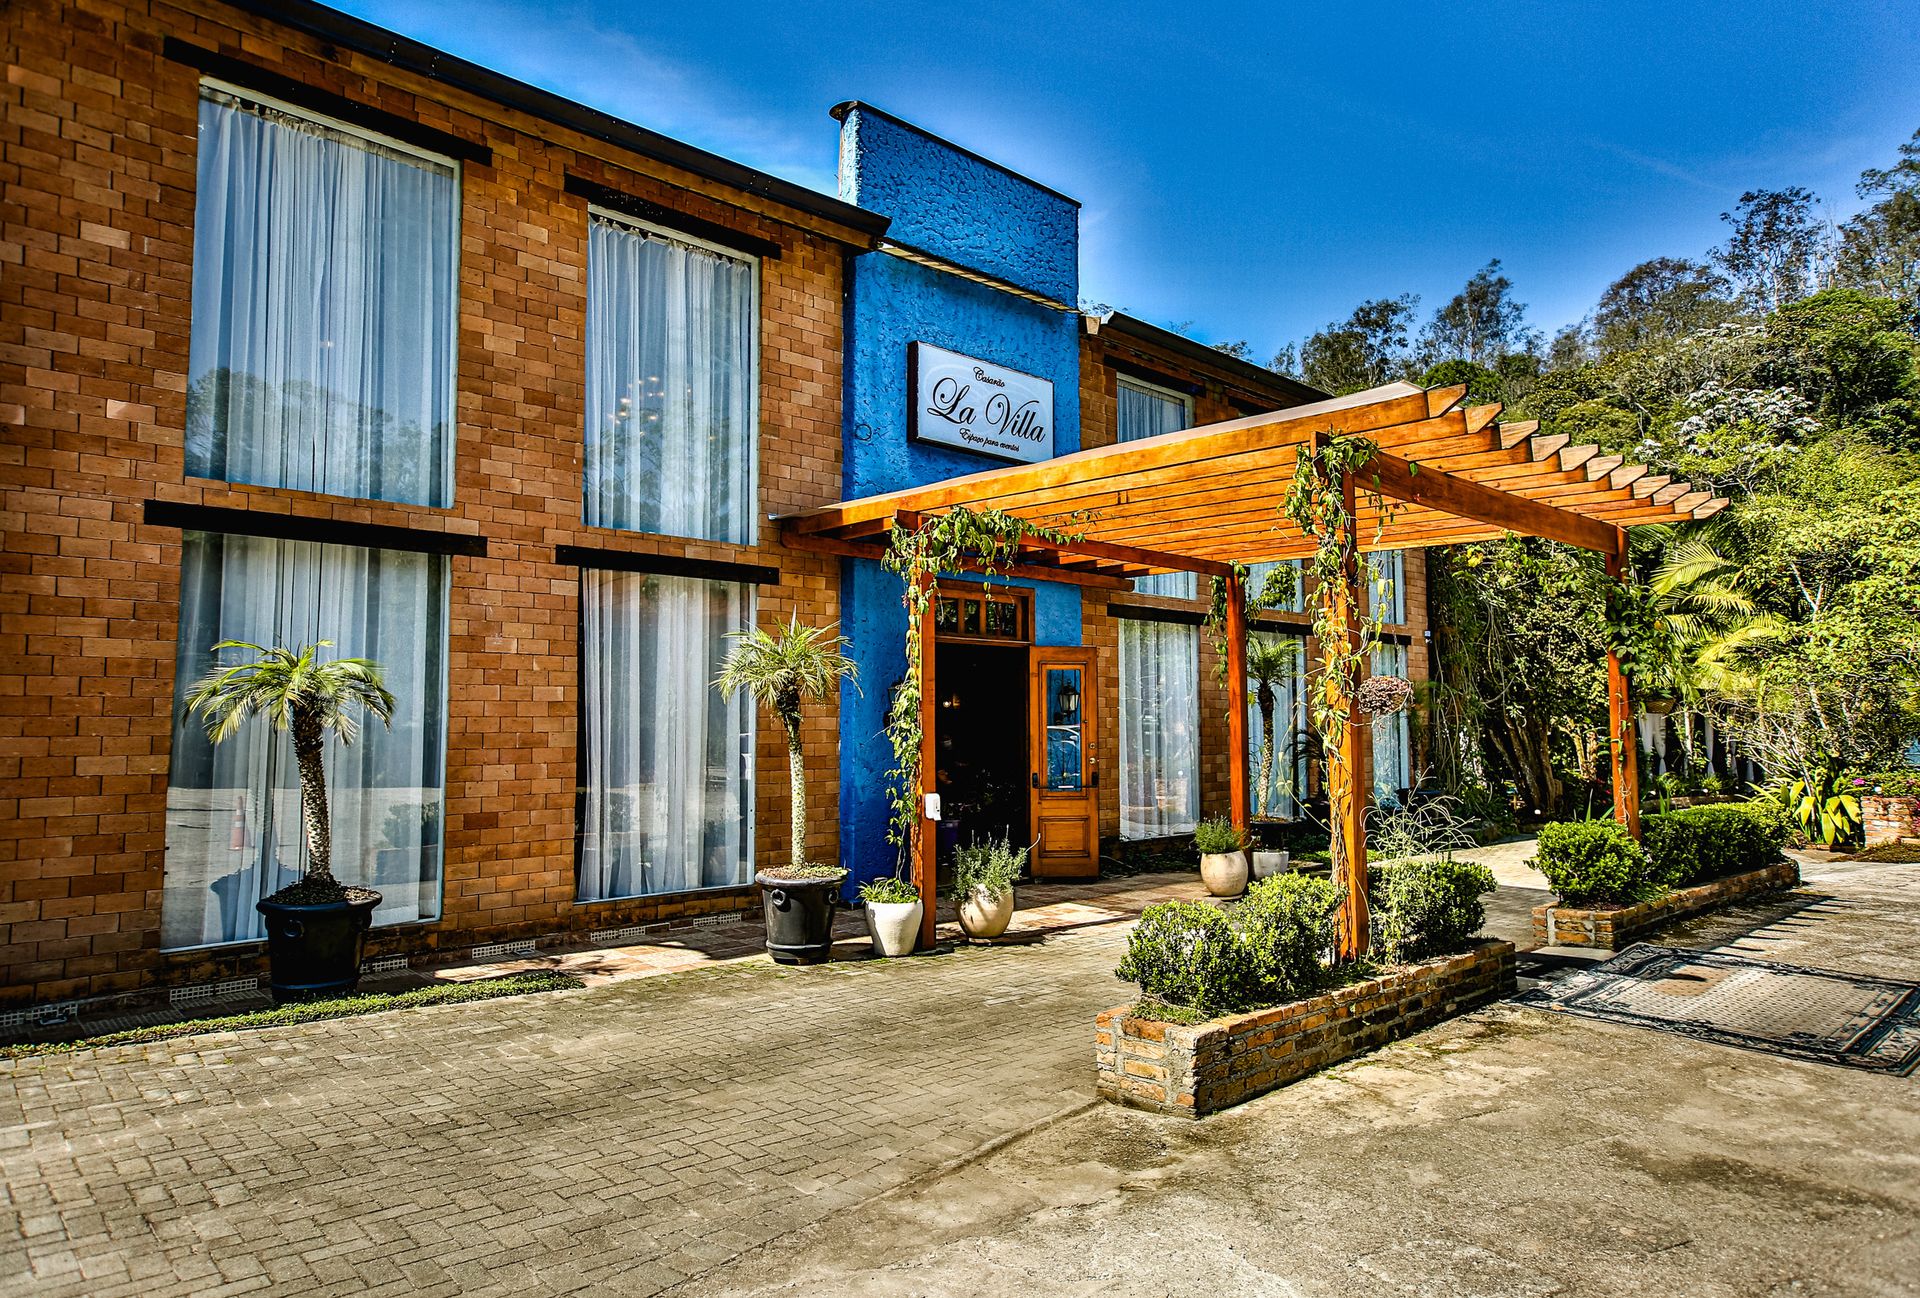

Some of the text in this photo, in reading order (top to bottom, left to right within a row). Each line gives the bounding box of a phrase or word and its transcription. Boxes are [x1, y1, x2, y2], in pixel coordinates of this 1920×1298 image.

[927, 377, 1046, 443] La Villa
[982, 437, 999, 448] para
[999, 442, 1020, 452] eventos
